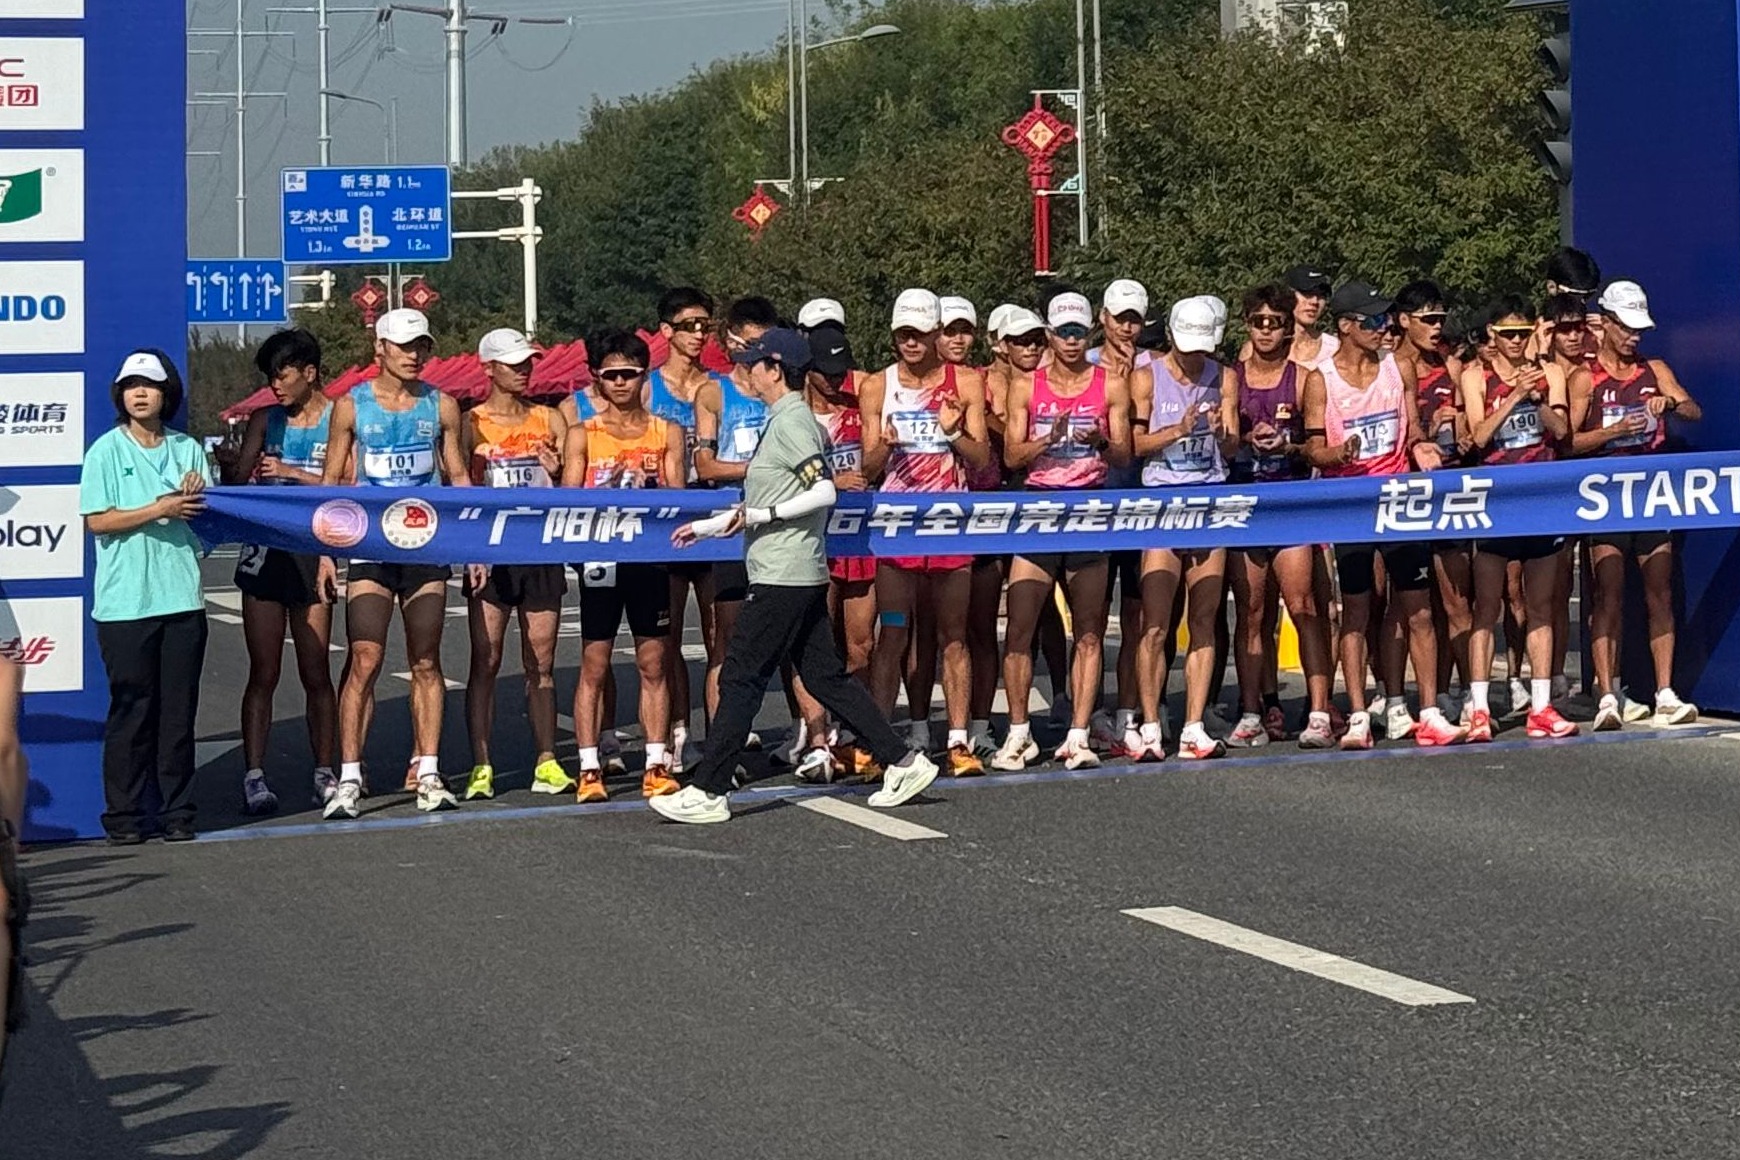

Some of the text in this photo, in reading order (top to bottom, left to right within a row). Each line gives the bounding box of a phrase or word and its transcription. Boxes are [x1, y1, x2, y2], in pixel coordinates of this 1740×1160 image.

[0, 84, 39, 107] 团
[340, 174, 391, 189] 新华路
[288, 208, 350, 225] 艺术大道
[392, 206, 444, 222] 北环道
[11, 425, 65, 435] SPORTS
[909, 421, 939, 435] 127
[1508, 413, 1537, 431] 190
[385, 453, 415, 469] 101
[829, 452, 856, 469] 128
[503, 467, 533, 482] 116
[826, 495, 1258, 538] 6年全国竞走锦标赛
[1374, 474, 1494, 535] 起点
